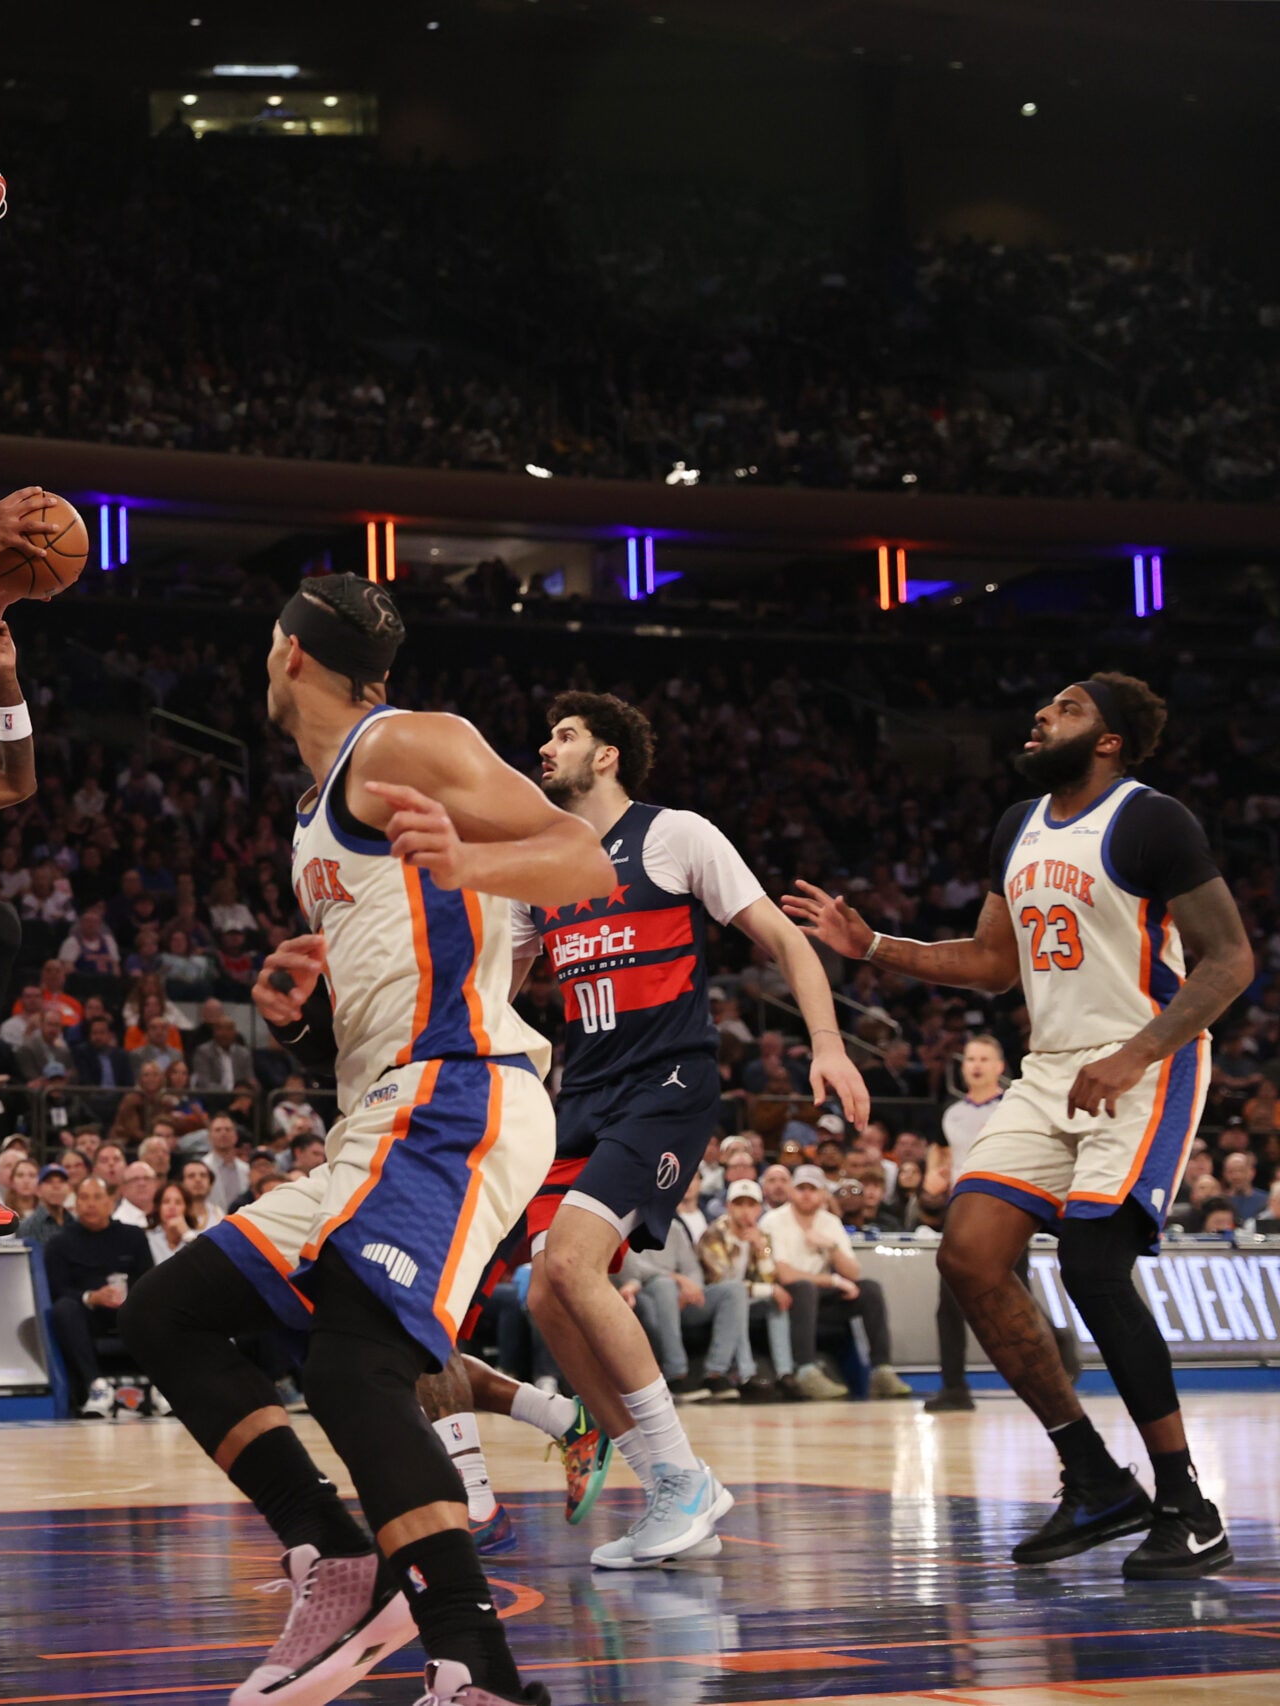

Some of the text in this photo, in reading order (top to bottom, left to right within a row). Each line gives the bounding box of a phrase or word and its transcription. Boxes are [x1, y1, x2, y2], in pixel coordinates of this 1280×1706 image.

[1008, 859, 1096, 908] NEW YORK
[1020, 904, 1085, 972] 23
[573, 976, 617, 1035] 00
